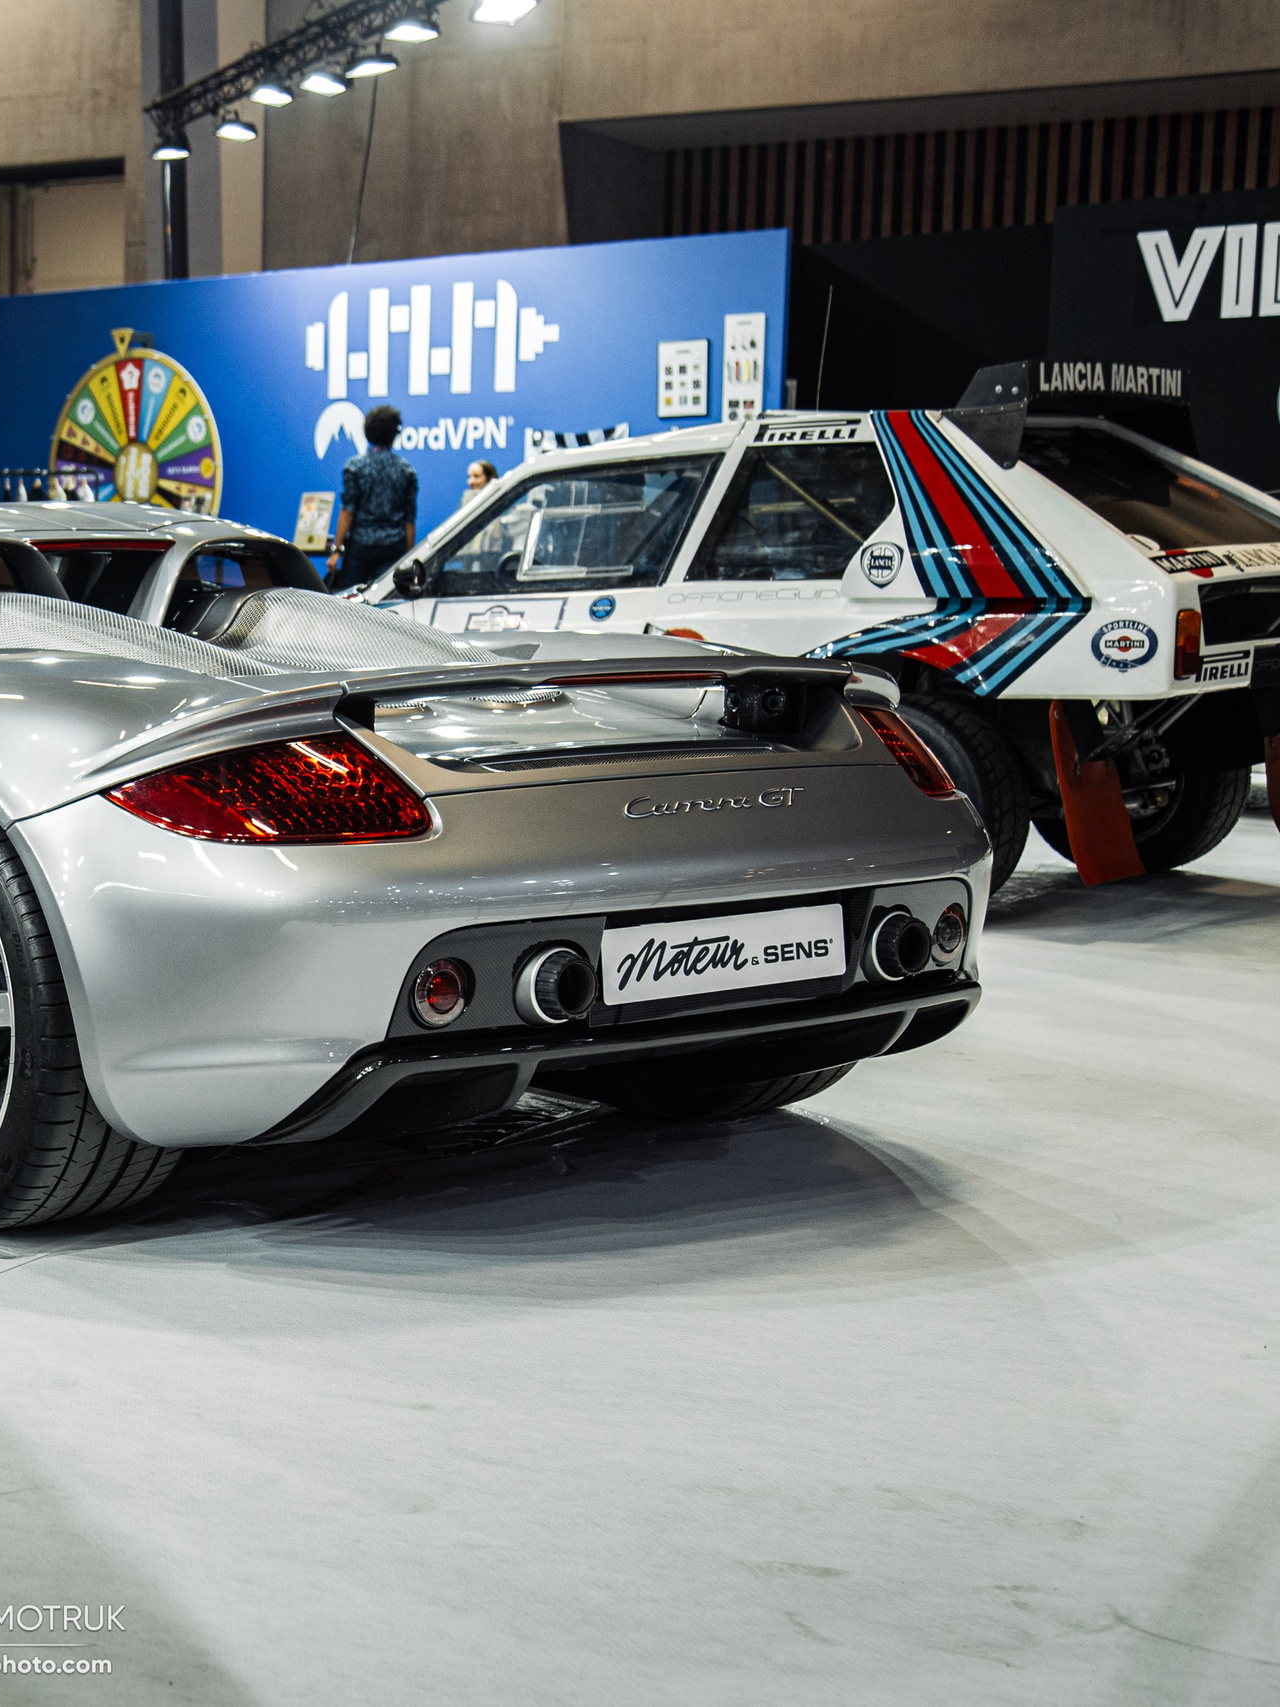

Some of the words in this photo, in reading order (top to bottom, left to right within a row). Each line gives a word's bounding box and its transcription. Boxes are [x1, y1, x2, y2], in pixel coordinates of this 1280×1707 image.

[1039, 362, 1105, 392] LANCIA
[1111, 363, 1182, 397] MARTINI
[393, 415, 507, 450] ordVPN
[753, 419, 862, 443] PIRELLI
[871, 558, 891, 566] LANCIA
[1151, 551, 1224, 572] MARTINI
[1102, 620, 1149, 634] SPORTLINE
[1106, 640, 1144, 648] MARTINI
[1195, 650, 1251, 682] PIRELLI
[624, 796, 753, 819] Carrera
[758, 787, 804, 807] GT
[617, 935, 749, 991] Moteur
[751, 957, 760, 966] &
[762, 938, 829, 964] SENS
